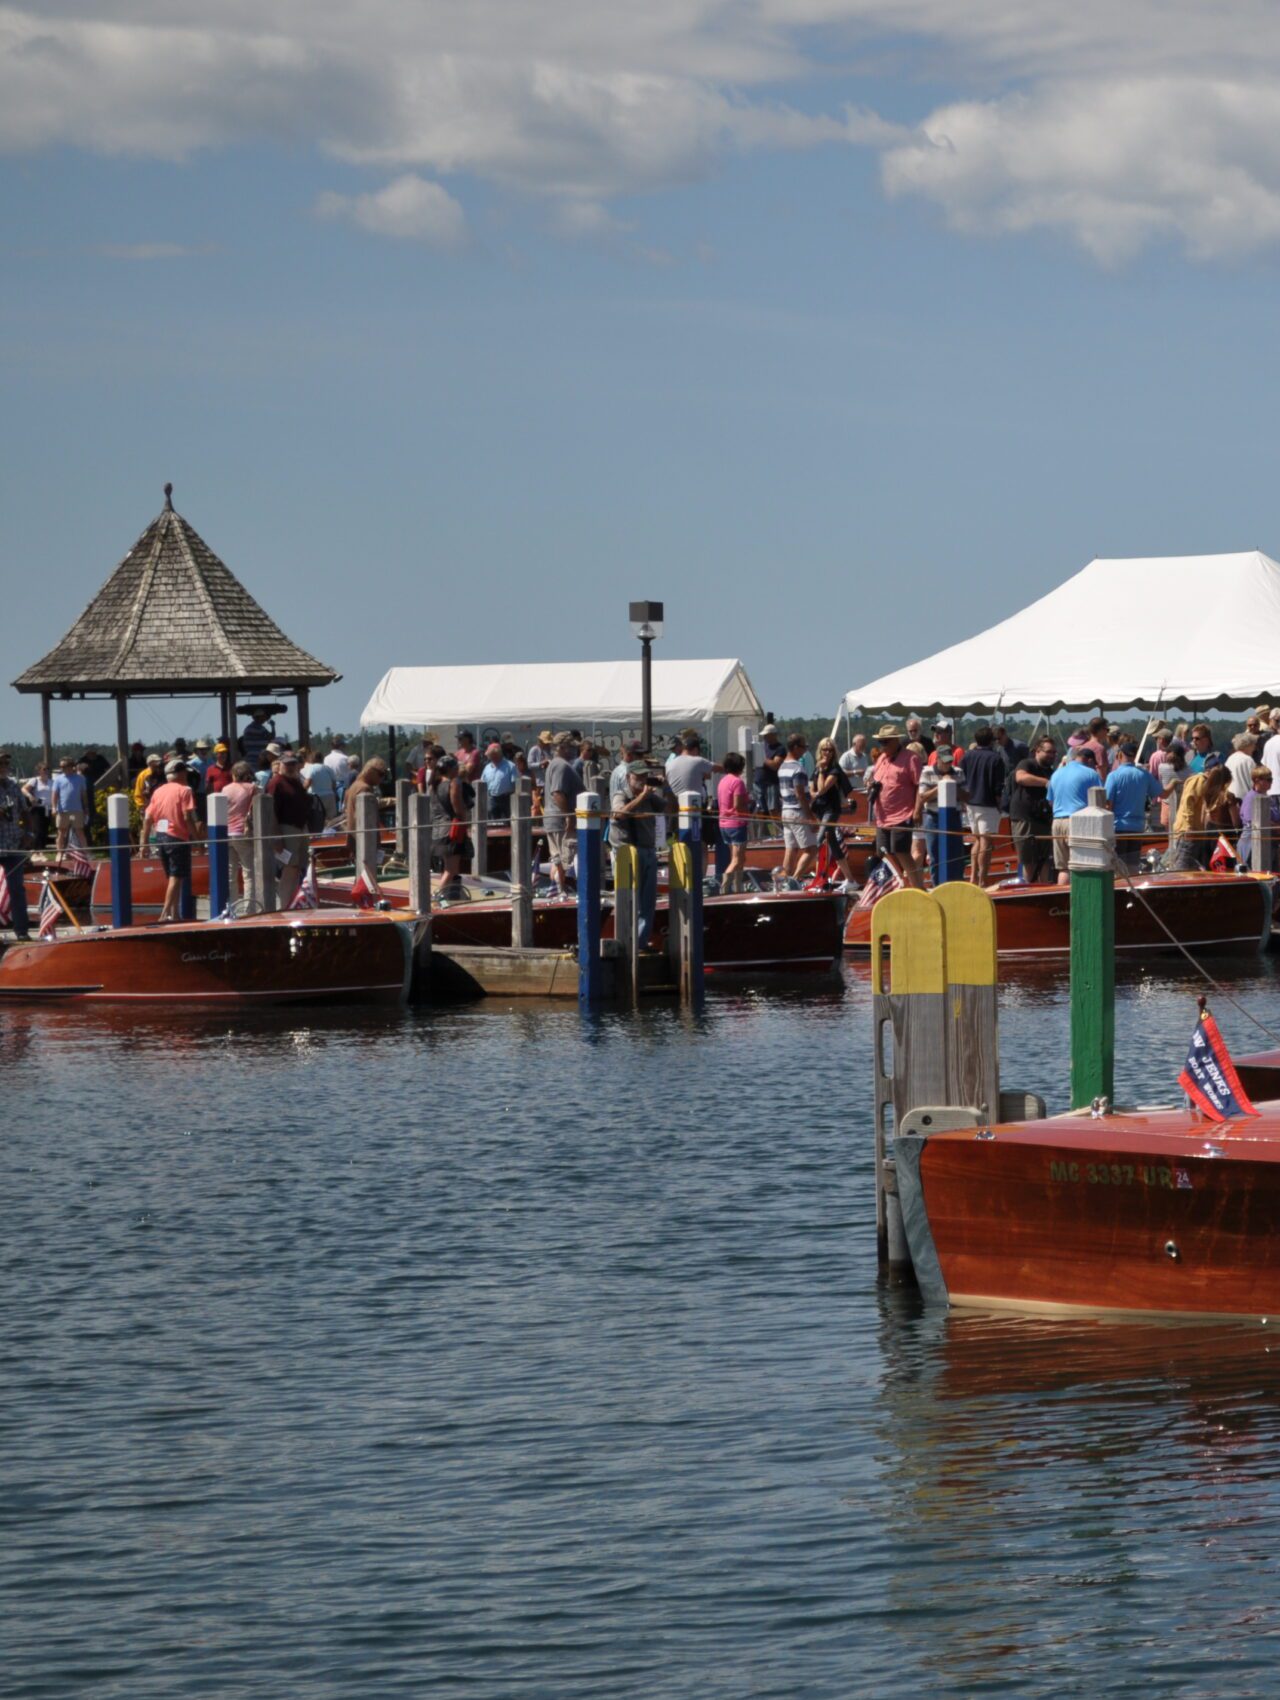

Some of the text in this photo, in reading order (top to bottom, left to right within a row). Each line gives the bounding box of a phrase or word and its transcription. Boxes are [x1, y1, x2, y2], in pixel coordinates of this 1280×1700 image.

[1188, 1056, 1224, 1110] BOAT WORKS
[1202, 1056, 1231, 1096] JENKS
[1050, 1159, 1080, 1182] MC
